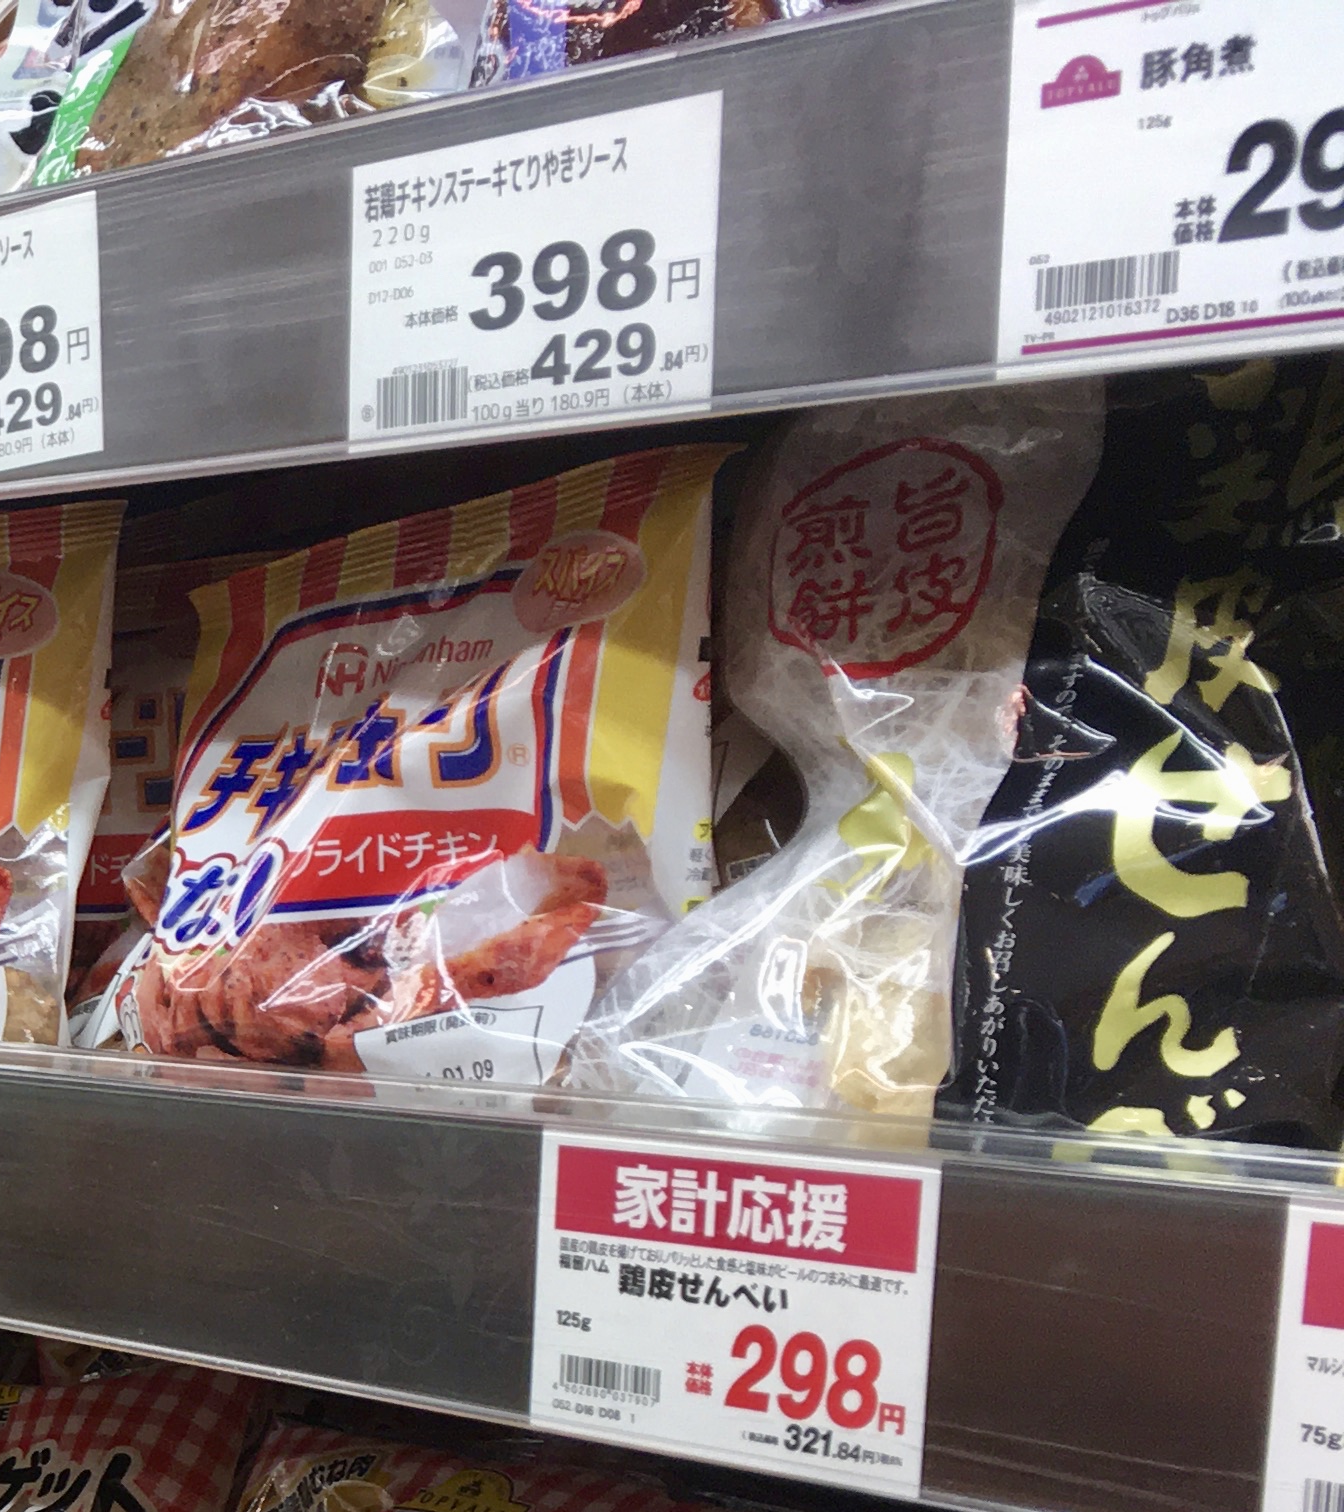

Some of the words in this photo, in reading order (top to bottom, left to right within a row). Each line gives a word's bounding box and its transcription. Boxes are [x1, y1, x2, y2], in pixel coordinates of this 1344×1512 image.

[1141, 34, 1257, 89] 豚角煮
[365, 137, 627, 222] 若鶏チキンステーキてりやきソース
[372, 223, 431, 247] 220g
[614, 1164, 848, 1253] 家計応援
[619, 1263, 789, 1314] 鶏皮せんべい
[556, 1309, 591, 1332] 125g
